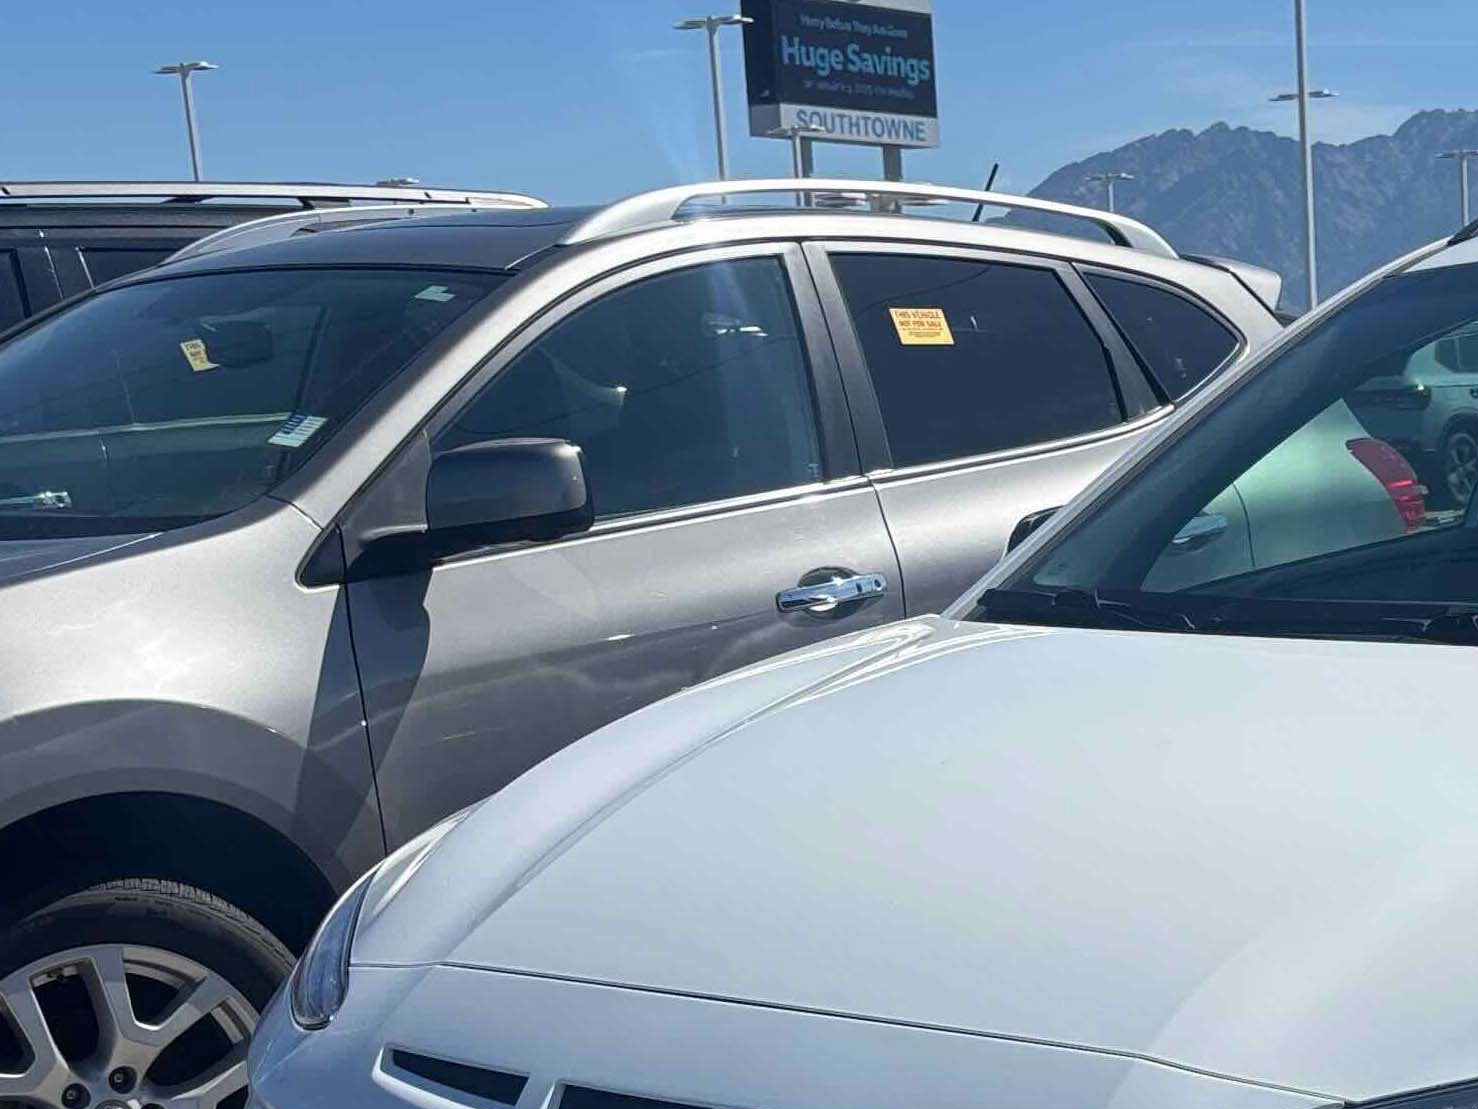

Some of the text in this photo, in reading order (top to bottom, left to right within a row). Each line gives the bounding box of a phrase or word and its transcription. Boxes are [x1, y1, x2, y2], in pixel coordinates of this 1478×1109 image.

[781, 36, 930, 87] Huge Savings
[796, 109, 927, 142] SOUTHTOWNE
